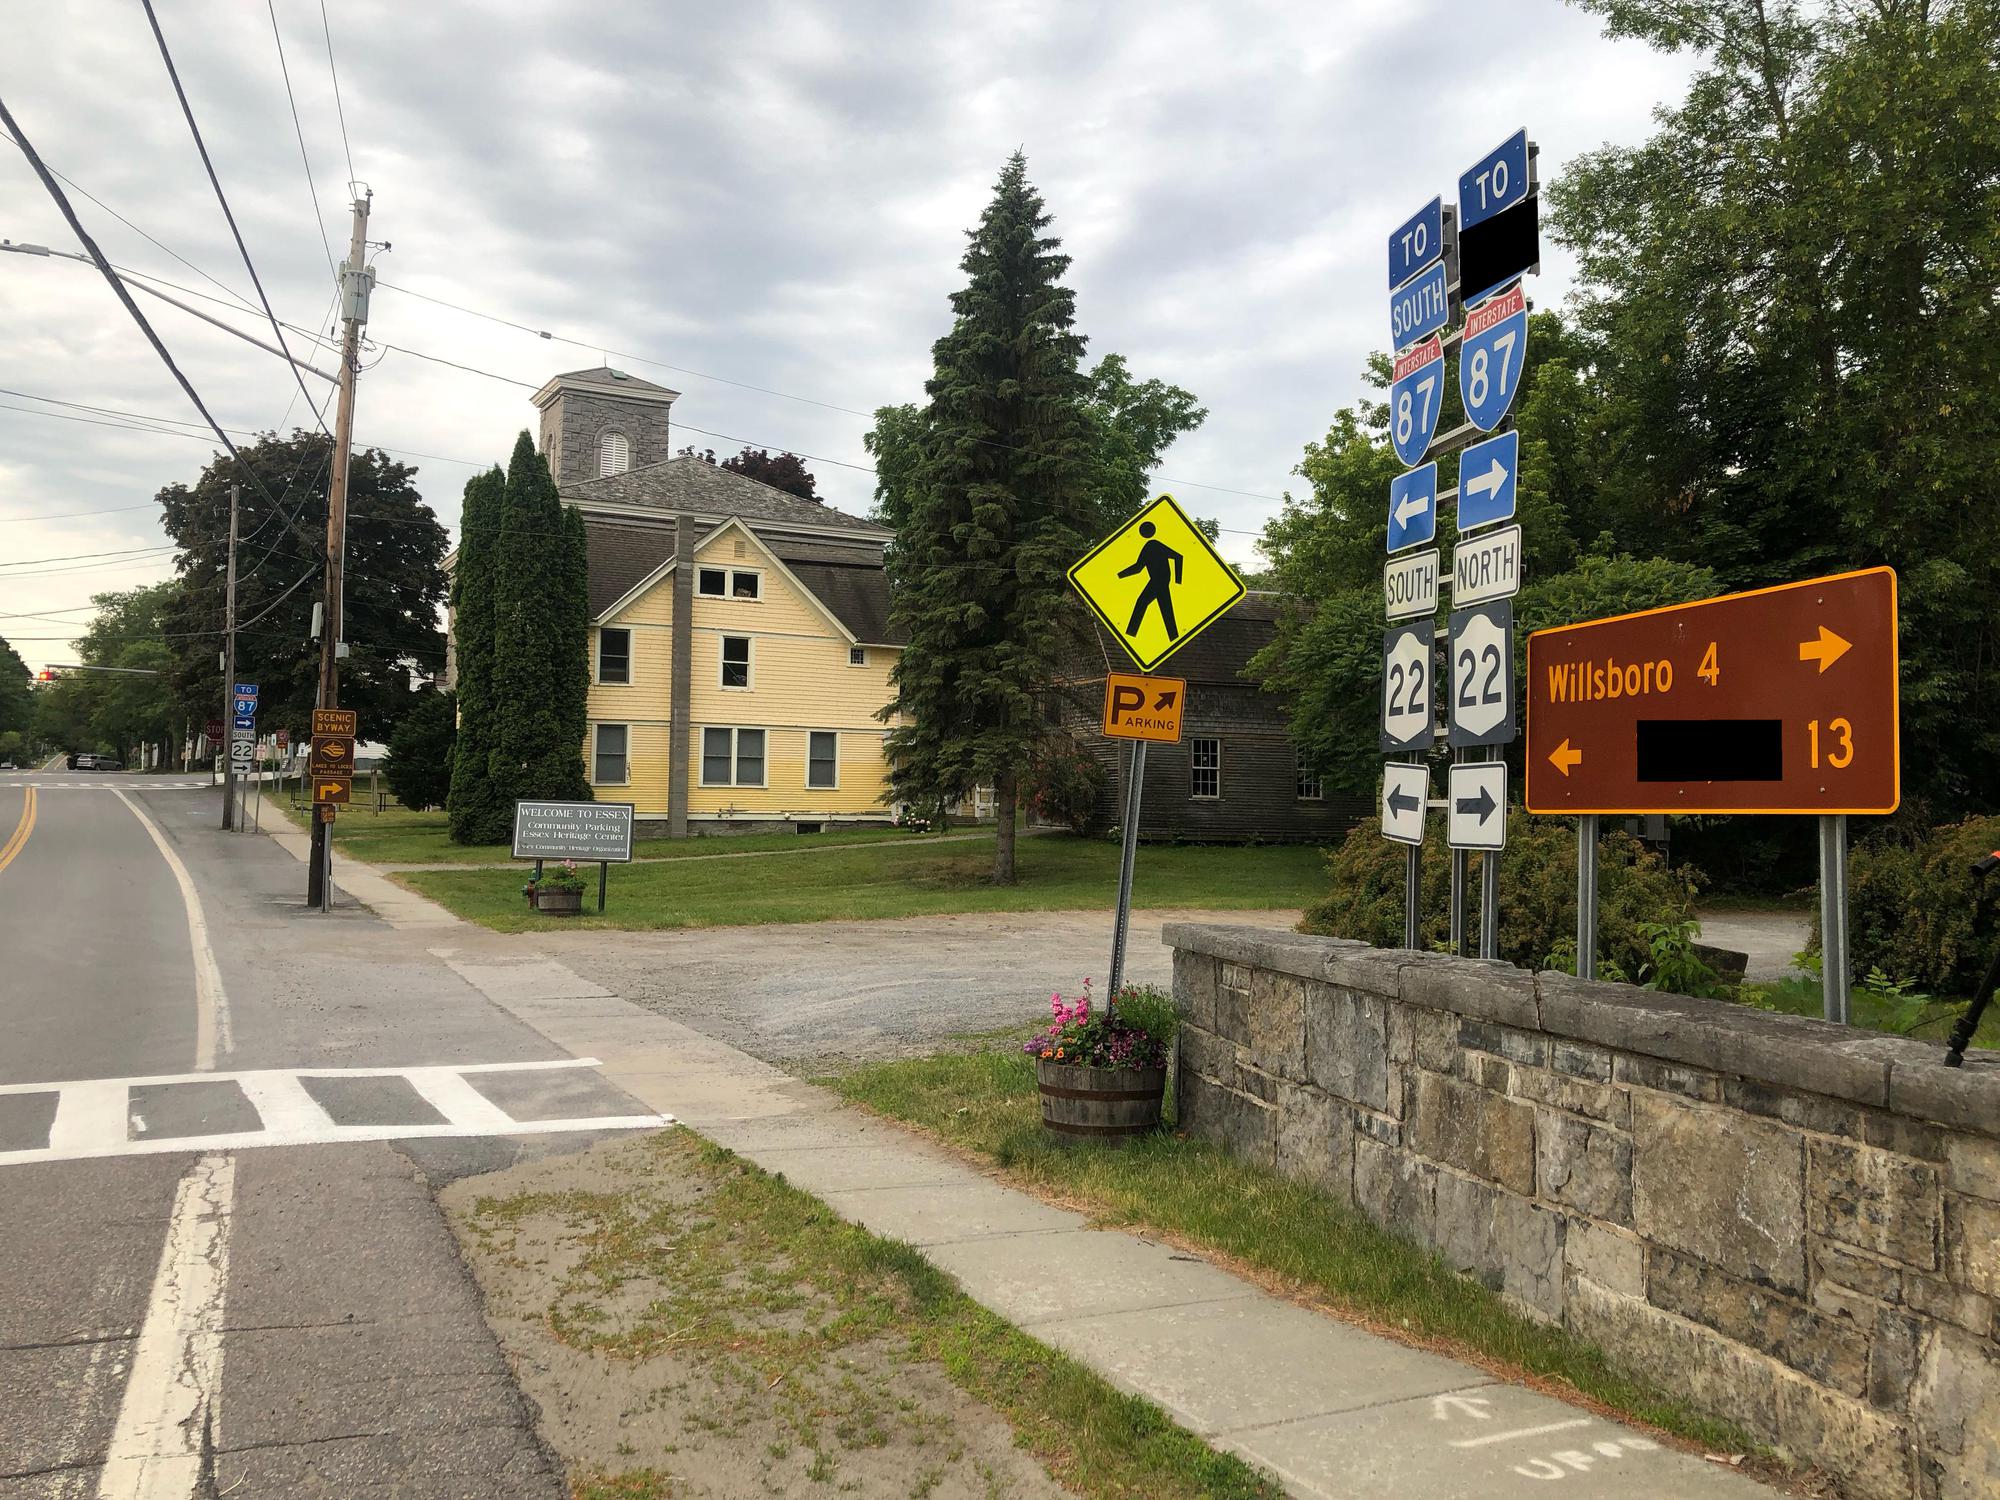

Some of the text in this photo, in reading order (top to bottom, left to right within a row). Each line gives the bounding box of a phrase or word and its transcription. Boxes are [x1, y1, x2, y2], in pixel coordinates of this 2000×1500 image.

[1476, 160, 1509, 210] TO
[1401, 222, 1427, 267] TO
[1393, 277, 1444, 339] SOUTH
[1470, 302, 1517, 333] INTERSTATE
[1397, 351, 1437, 379] INTERSTATE
[1469, 329, 1516, 408] 87
[1397, 375, 1435, 445] 87
[1387, 564, 1433, 607] SOUTH
[1457, 542, 1515, 592] NORTH
[241, 686, 252, 694] TO
[1388, 659, 1425, 717] 22
[1458, 643, 1502, 708] 22
[1548, 641, 1720, 704] Willsboro 4
[237, 701, 255, 711] 87
[317, 713, 352, 722] SCENIC
[317, 722, 351, 731] BYWAY
[233, 745, 252, 757] 22
[1808, 717, 1854, 769] 13
[521, 808, 628, 820] WELCOME TO ESSEX
[522, 830, 625, 841] Essex Heritage Center
[528, 820, 621, 833] Community Parking
